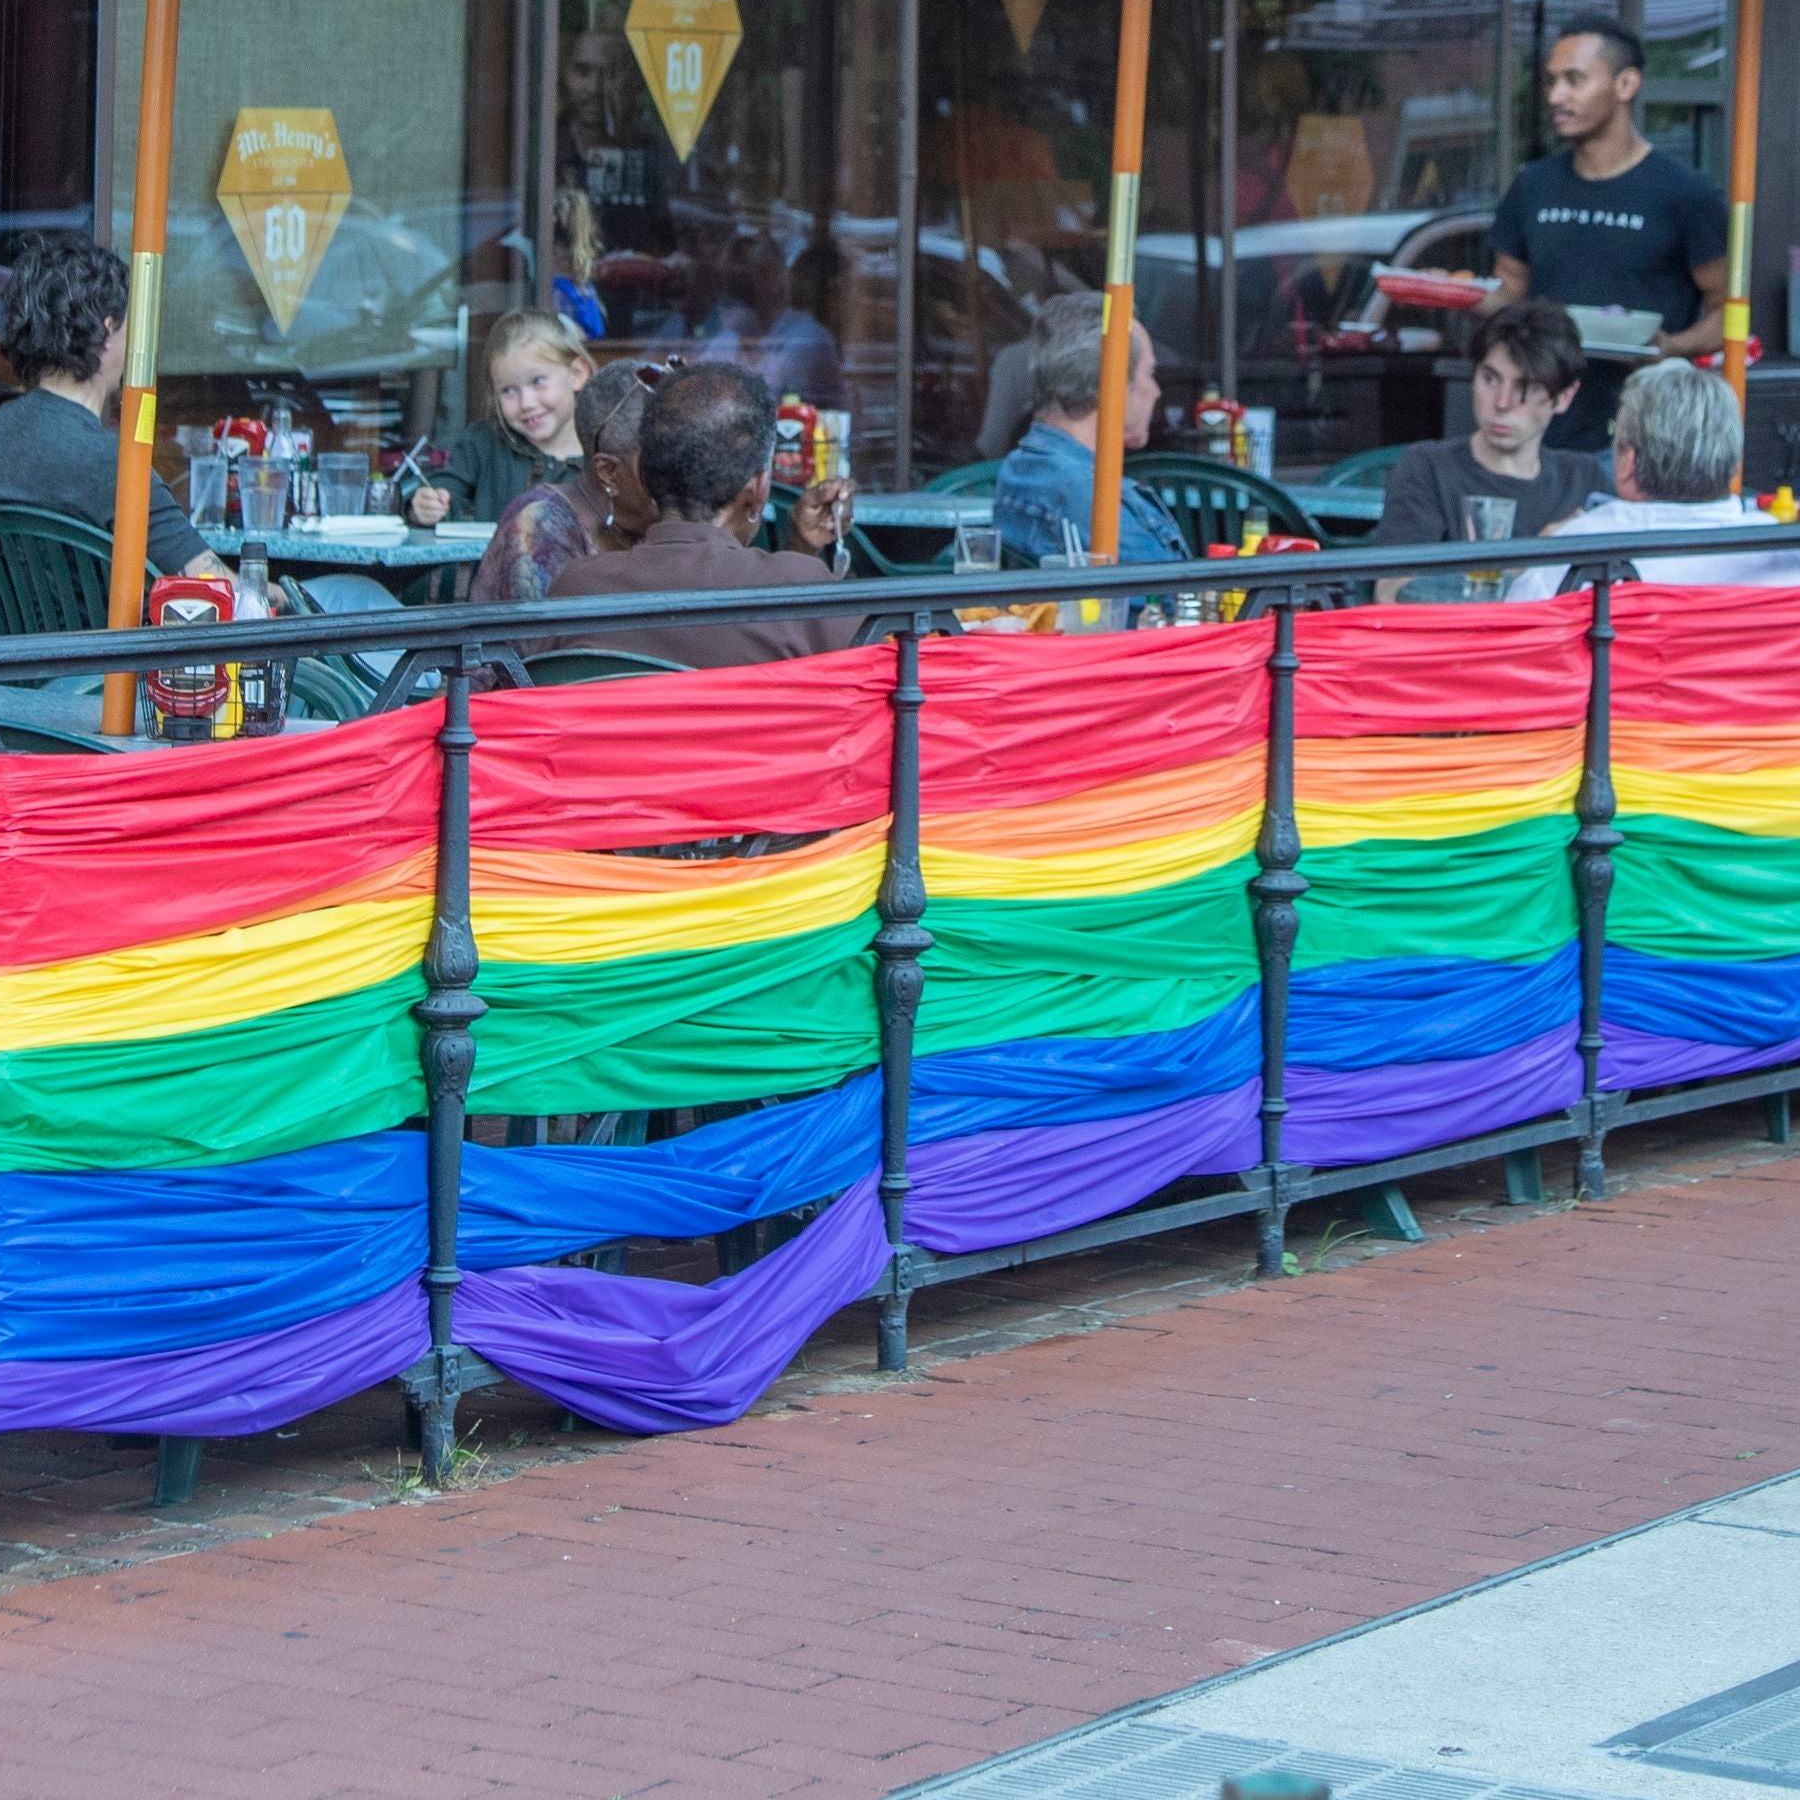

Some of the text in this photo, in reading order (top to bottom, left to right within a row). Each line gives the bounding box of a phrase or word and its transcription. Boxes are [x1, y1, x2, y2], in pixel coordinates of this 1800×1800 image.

[666, 41, 703, 95] 60
[236, 120, 336, 163] Mr. Henry's
[264, 204, 307, 263] 60
